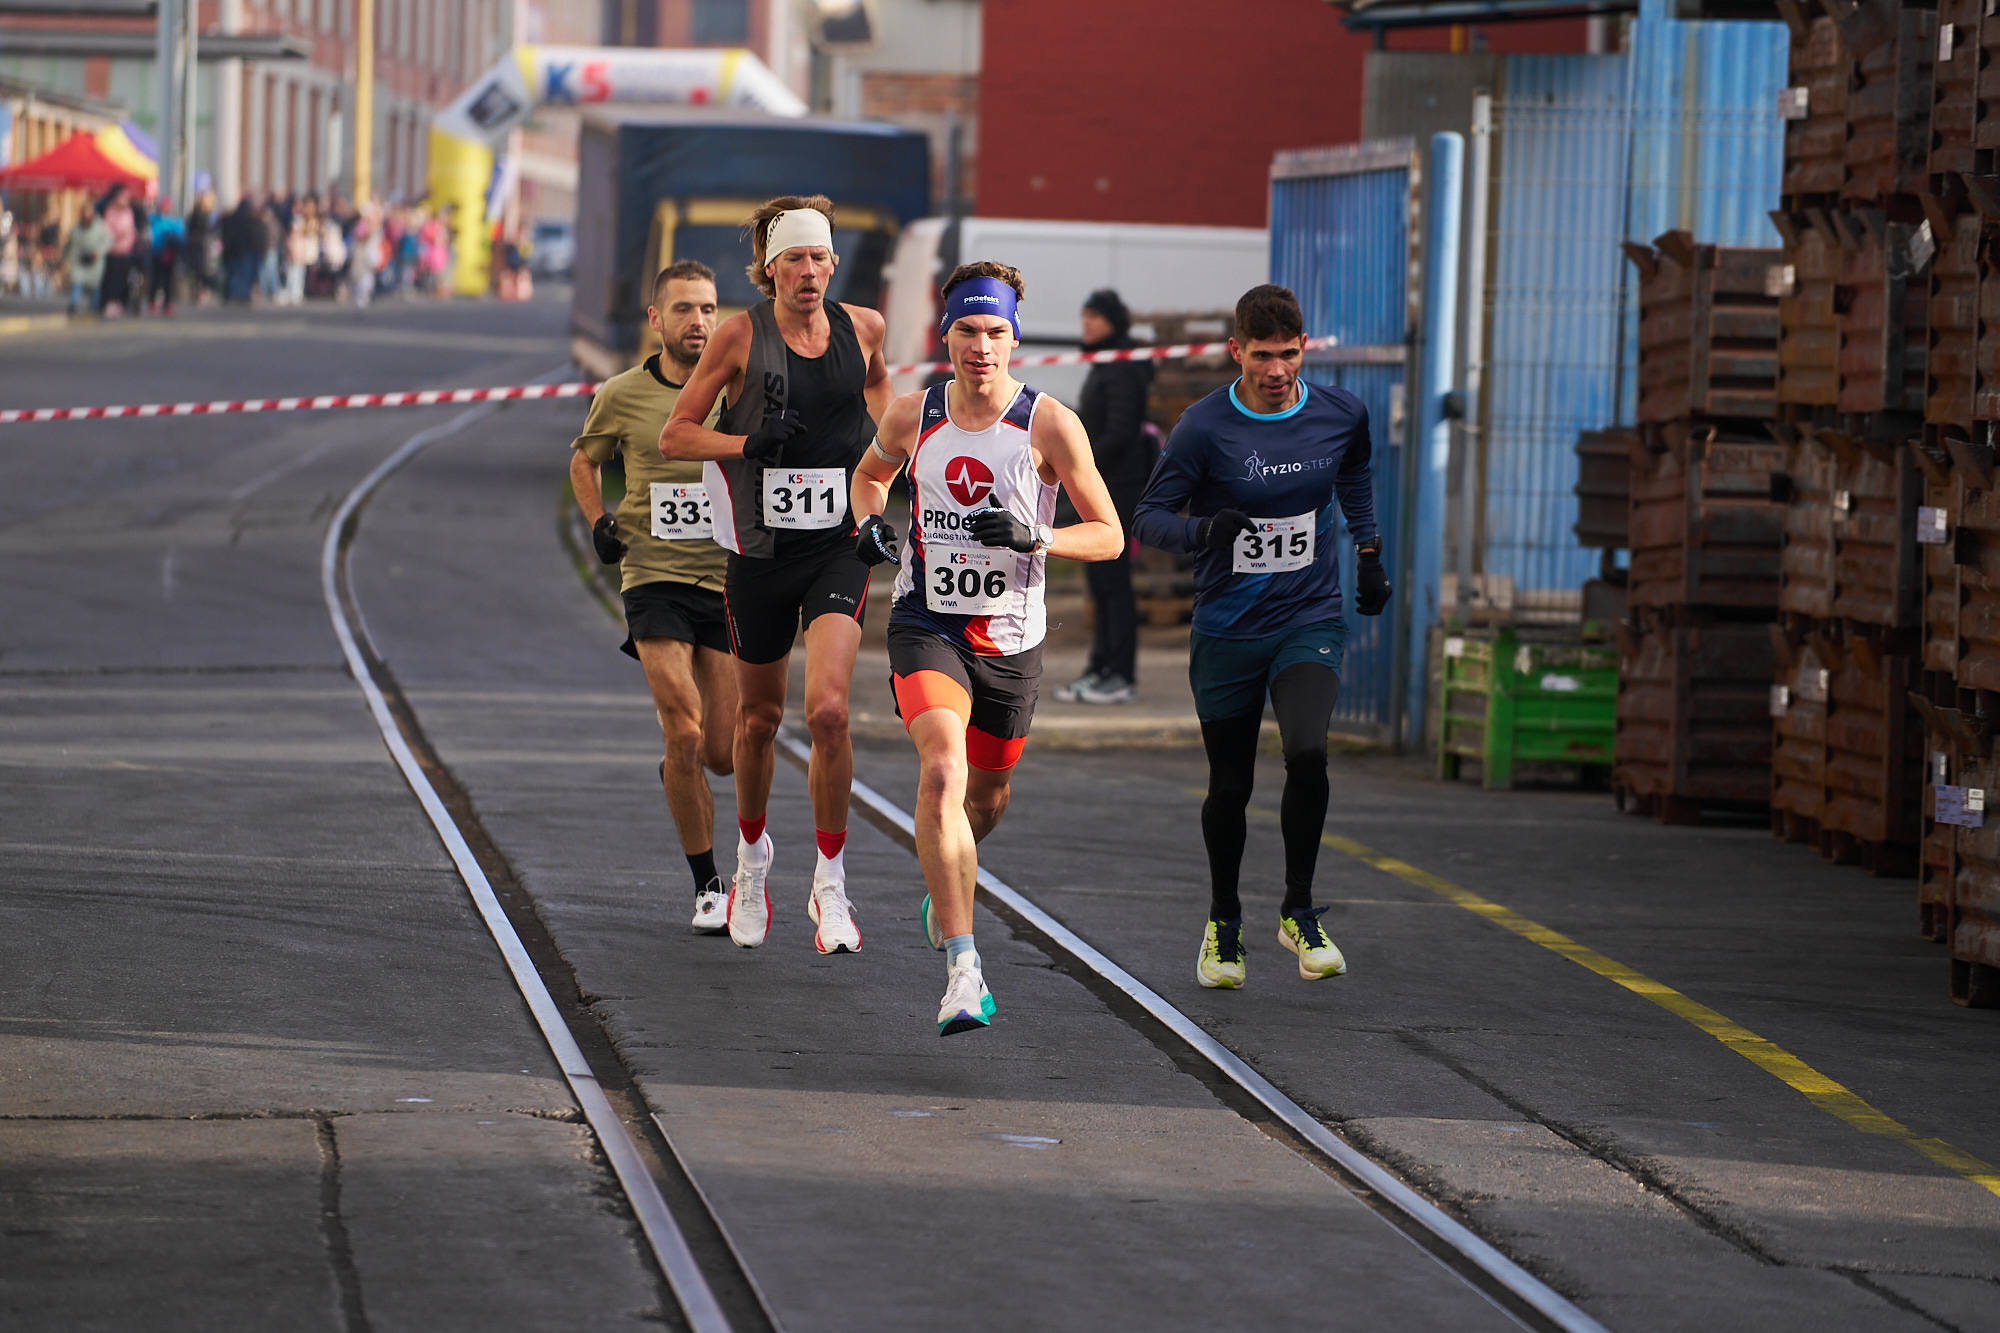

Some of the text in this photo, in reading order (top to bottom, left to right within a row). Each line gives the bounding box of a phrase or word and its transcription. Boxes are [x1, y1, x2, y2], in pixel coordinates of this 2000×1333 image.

[1263, 458, 1333, 476] FYZIOSTEP
[788, 474, 803, 484] K5
[673, 488, 687, 498] K5
[772, 487, 834, 513] 311
[924, 509, 971, 531] PROe
[1259, 523, 1274, 533] K5
[1242, 530, 1308, 559] 315
[950, 553, 967, 564] K5
[933, 566, 1006, 598] 306
